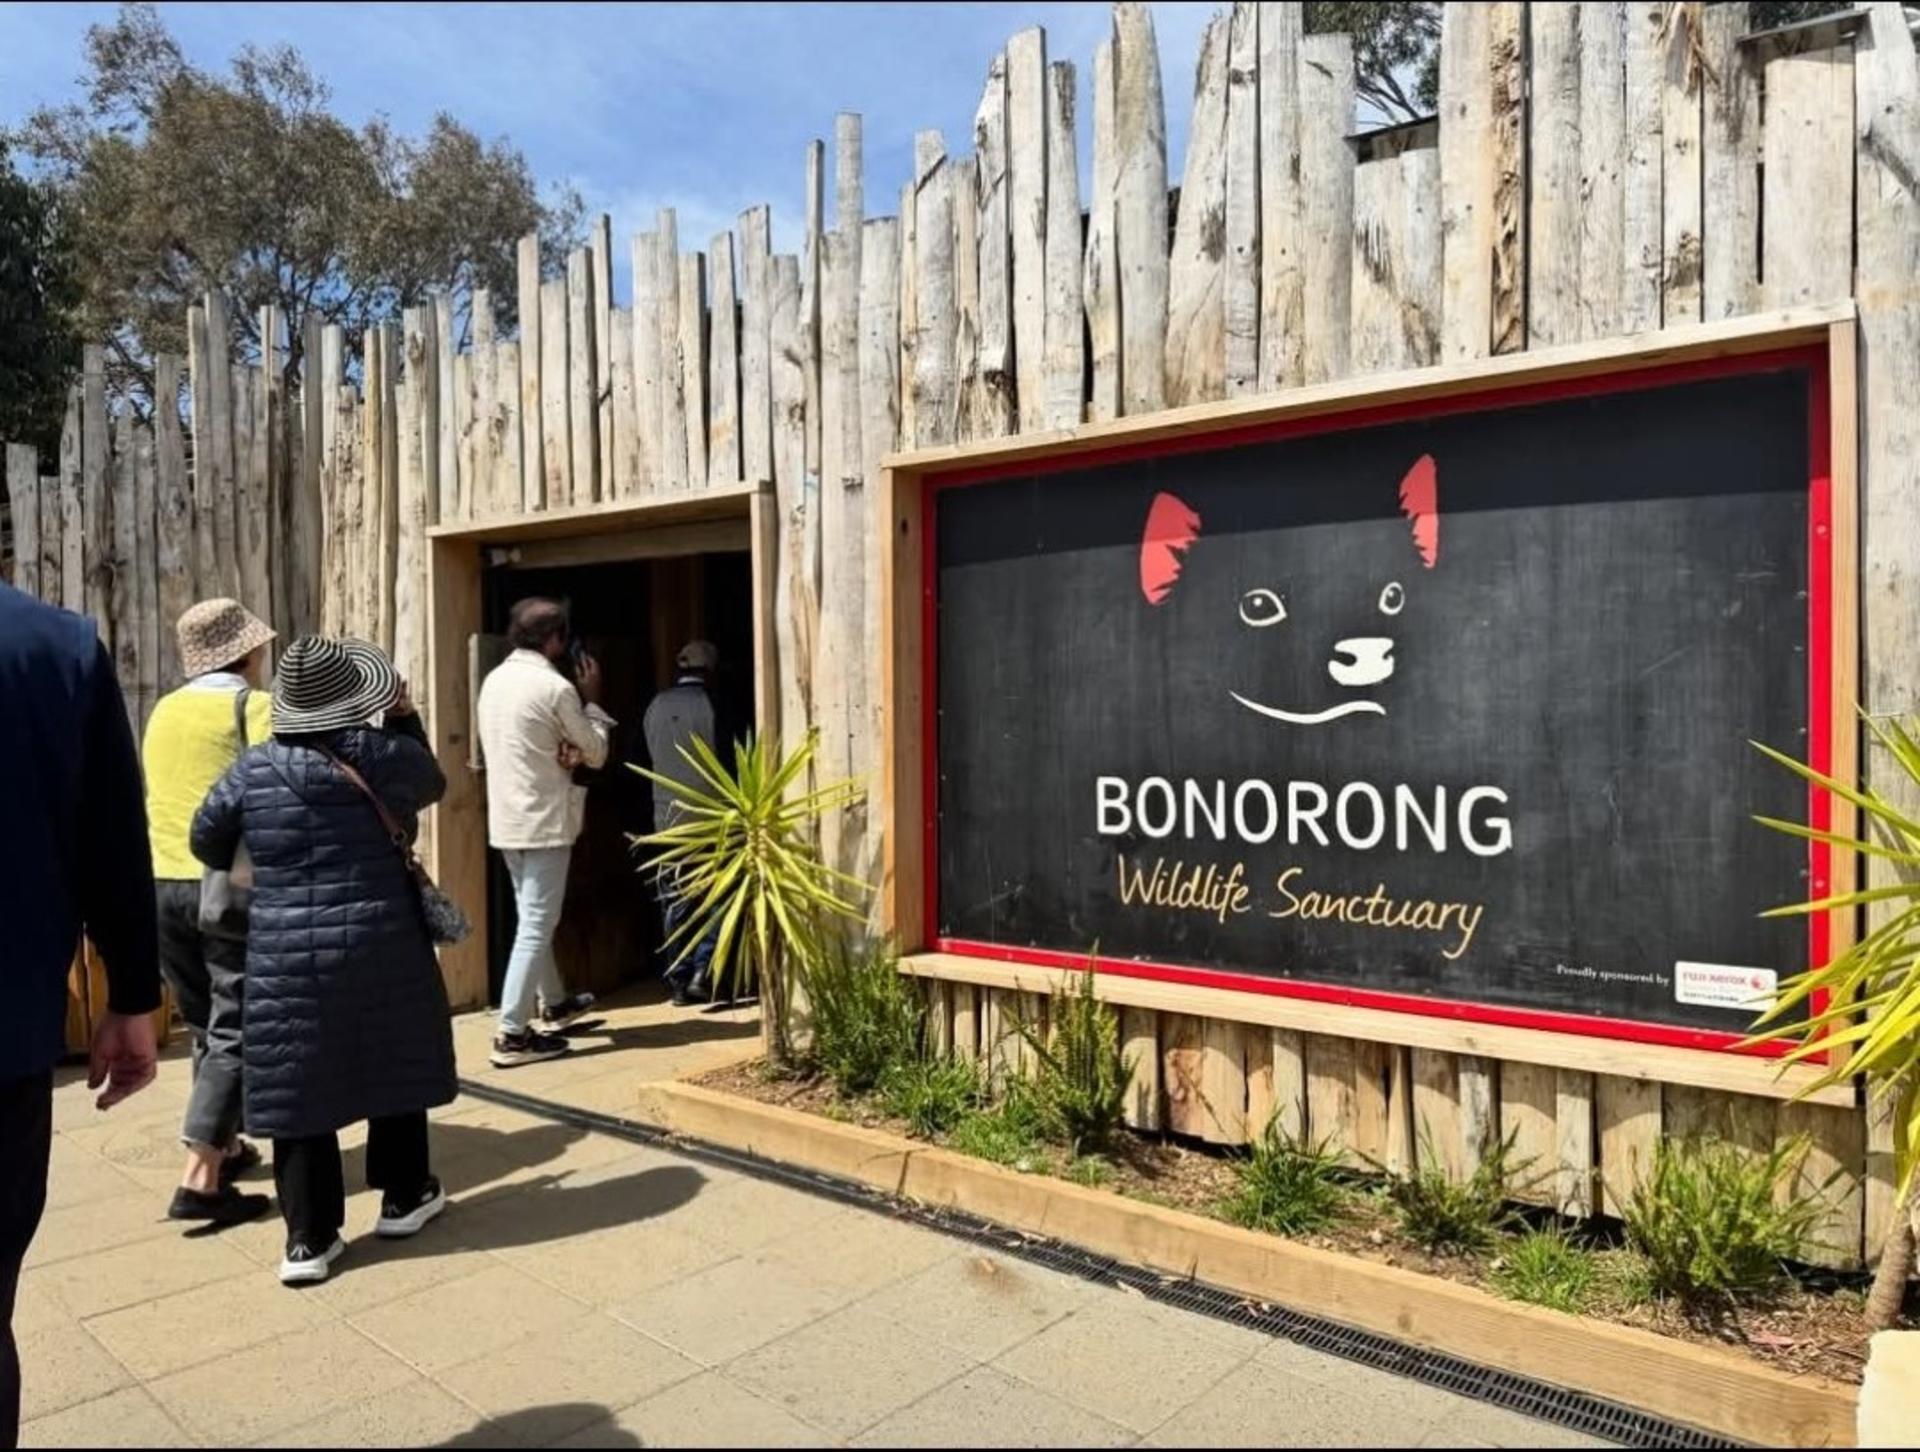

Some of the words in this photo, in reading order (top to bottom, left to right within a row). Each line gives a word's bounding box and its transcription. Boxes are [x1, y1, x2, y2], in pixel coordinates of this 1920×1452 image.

[1096, 776, 1512, 857] BONORONG
[1118, 853, 1251, 924] Wildlife
[1268, 868, 1482, 959] Sanctuary
[1557, 964, 1597, 979] Proudly
[1599, 969, 1654, 984] sponsored
[1656, 973, 1670, 987] by
